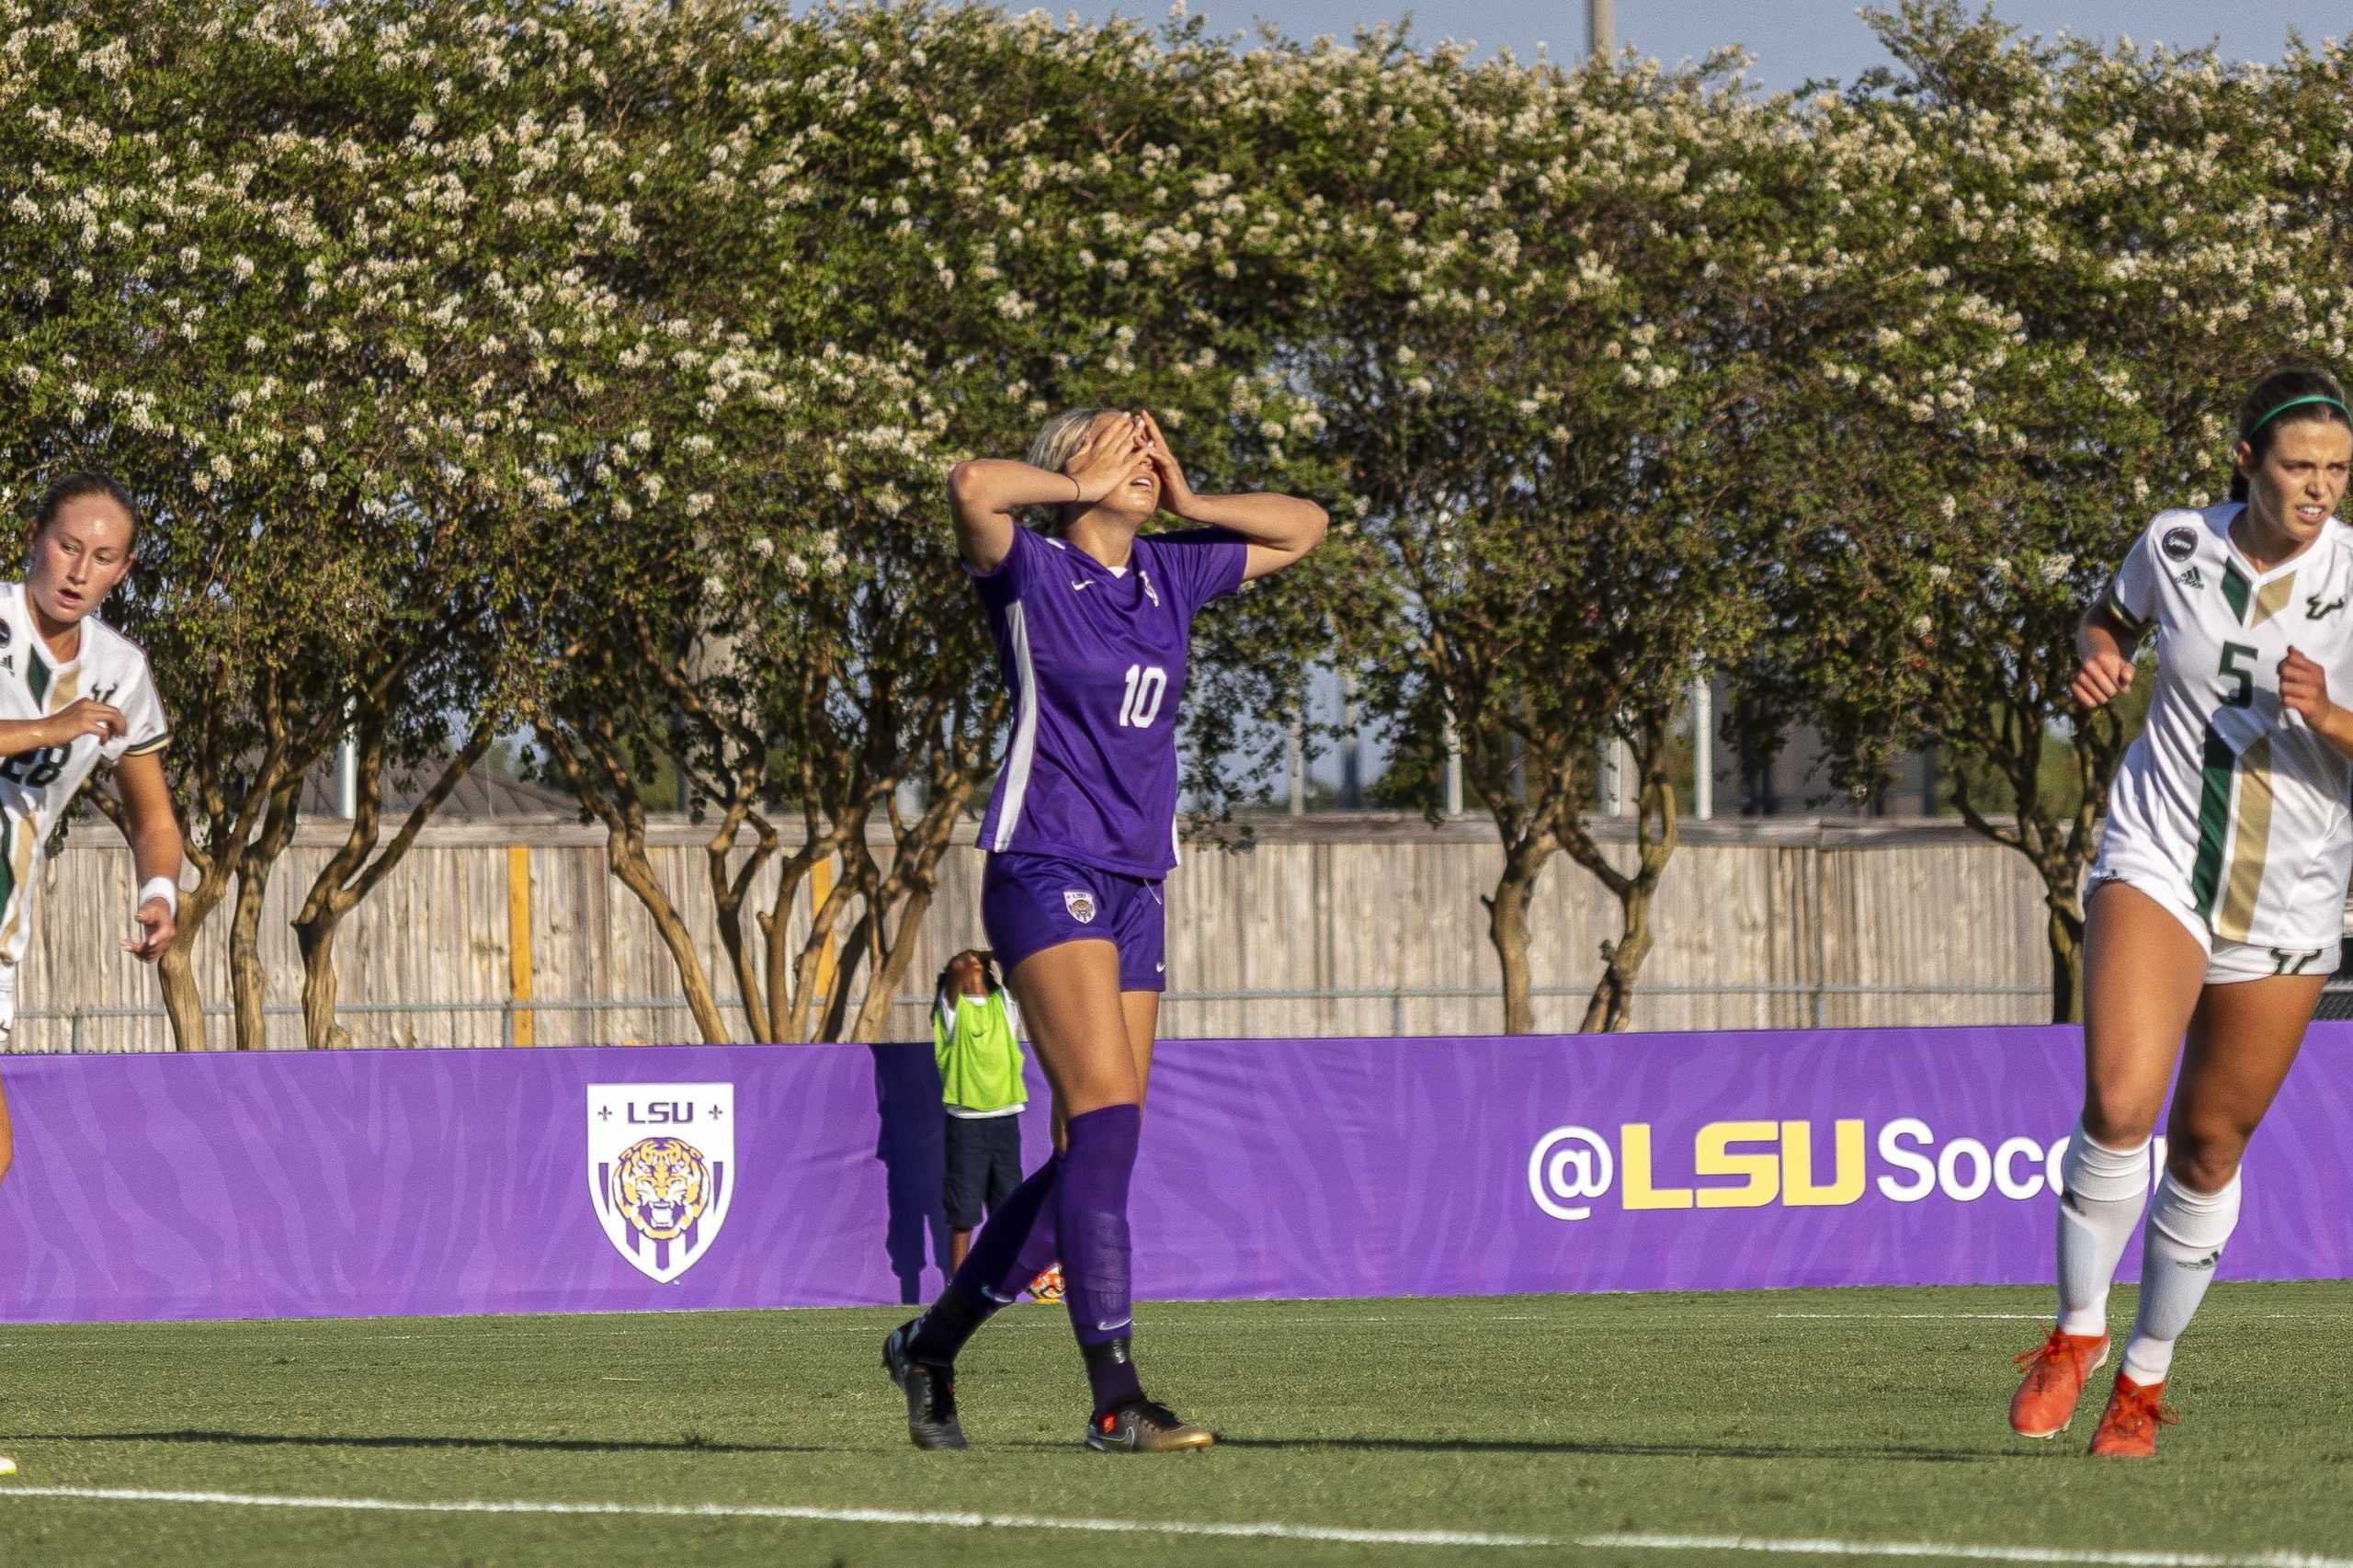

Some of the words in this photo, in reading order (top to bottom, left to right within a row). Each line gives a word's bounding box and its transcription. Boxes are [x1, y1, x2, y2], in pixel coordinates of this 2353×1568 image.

[1120, 665, 1167, 728] 10
[2218, 641, 2258, 710] 5
[628, 1102, 693, 1124] LSU
[1528, 1118, 2166, 1221] @LSUSoc
